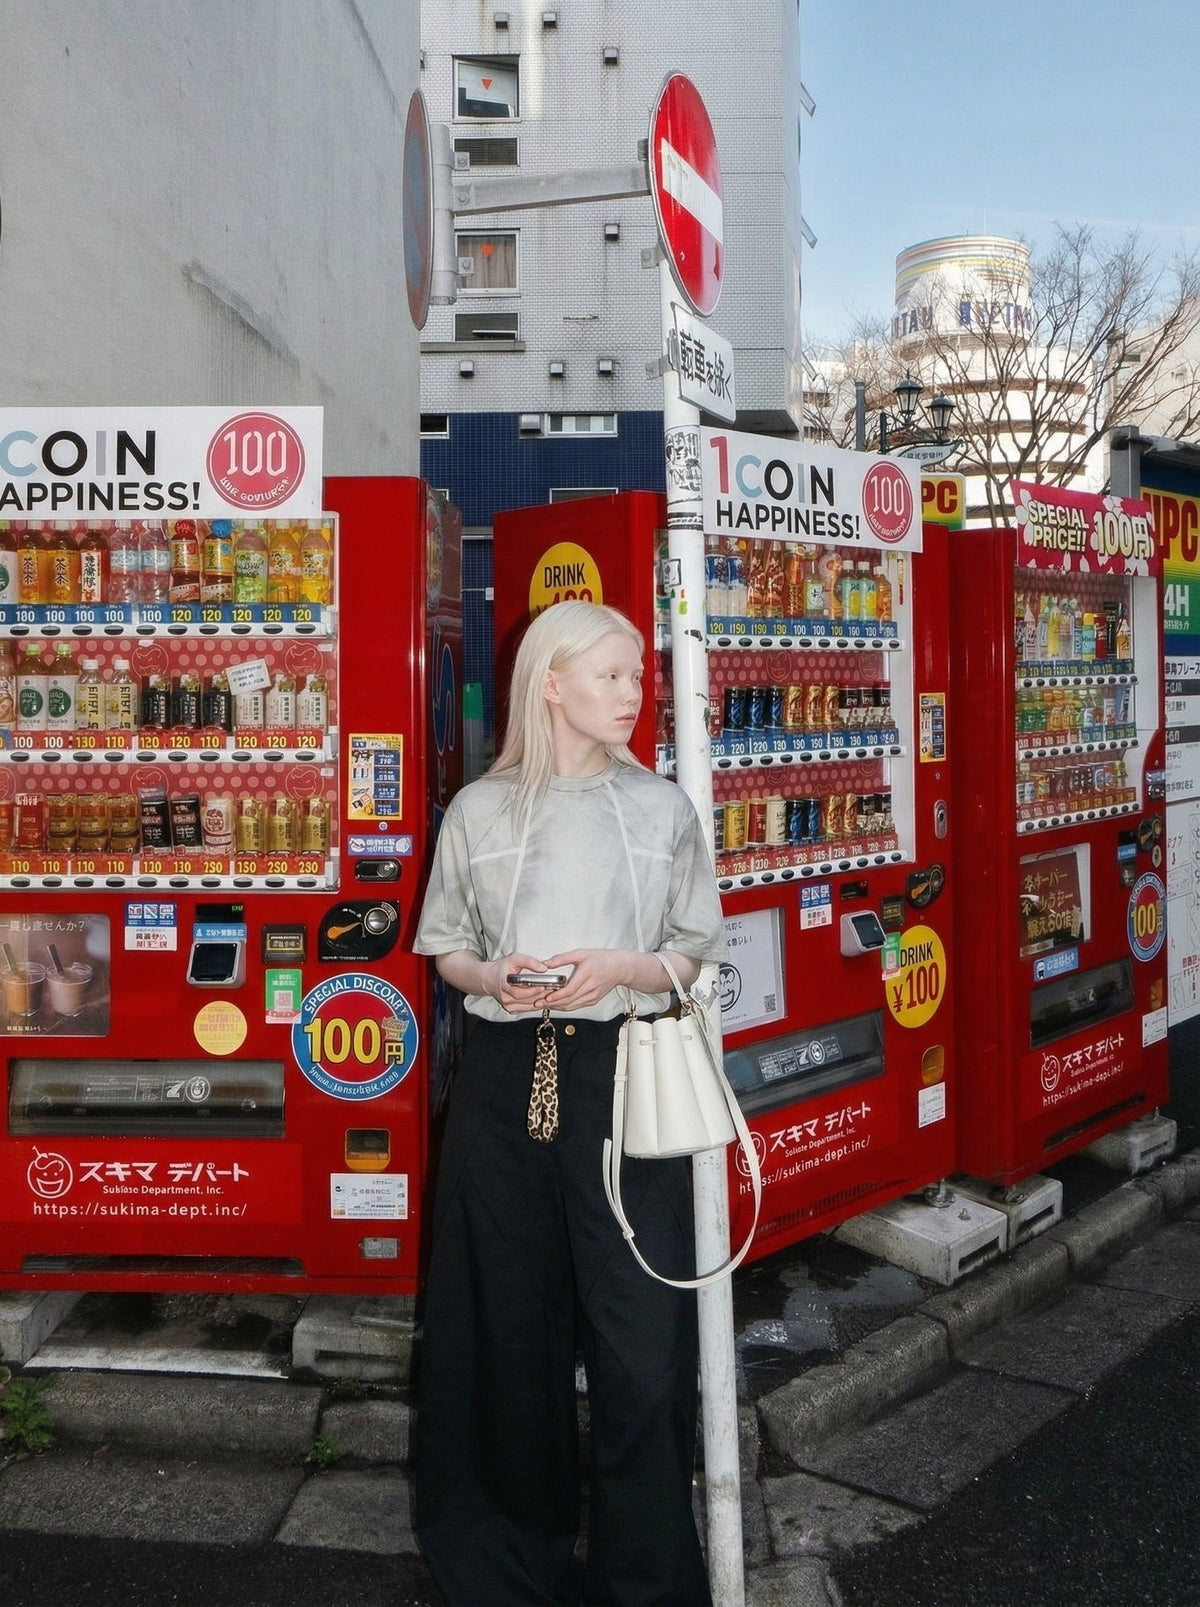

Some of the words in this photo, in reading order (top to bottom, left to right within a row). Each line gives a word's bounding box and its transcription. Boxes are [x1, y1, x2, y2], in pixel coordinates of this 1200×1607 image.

[223, 430, 287, 477] 100
[0, 482, 199, 511] APPINESS!
[870, 475, 905, 517] 100
[716, 499, 861, 541] HAPPINESS!
[1033, 524, 1086, 552] PRICE!!
[1095, 510, 1151, 559] 100円
[544, 562, 586, 588] DRINK
[172, 609, 192, 622] 120
[202, 609, 222, 622] 120
[232, 609, 252, 622] 120
[262, 609, 282, 622] 120
[292, 609, 312, 622] 120
[14, 736, 33, 748] 100
[43, 736, 63, 748] 100
[170, 736, 190, 748] 120
[237, 736, 258, 748] 120
[266, 736, 287, 748] 120
[296, 736, 316, 748] 120
[900, 941, 934, 968] DRINK
[1062, 1045, 1093, 1072] スキマ
[770, 1118, 819, 1152] スキマ
[79, 1162, 157, 1182] スキマ
[141, 1185, 203, 1197] Department,
[206, 1185, 224, 1194] Inc.
[33, 1202, 248, 1220] https://sukima-dept.inc/
